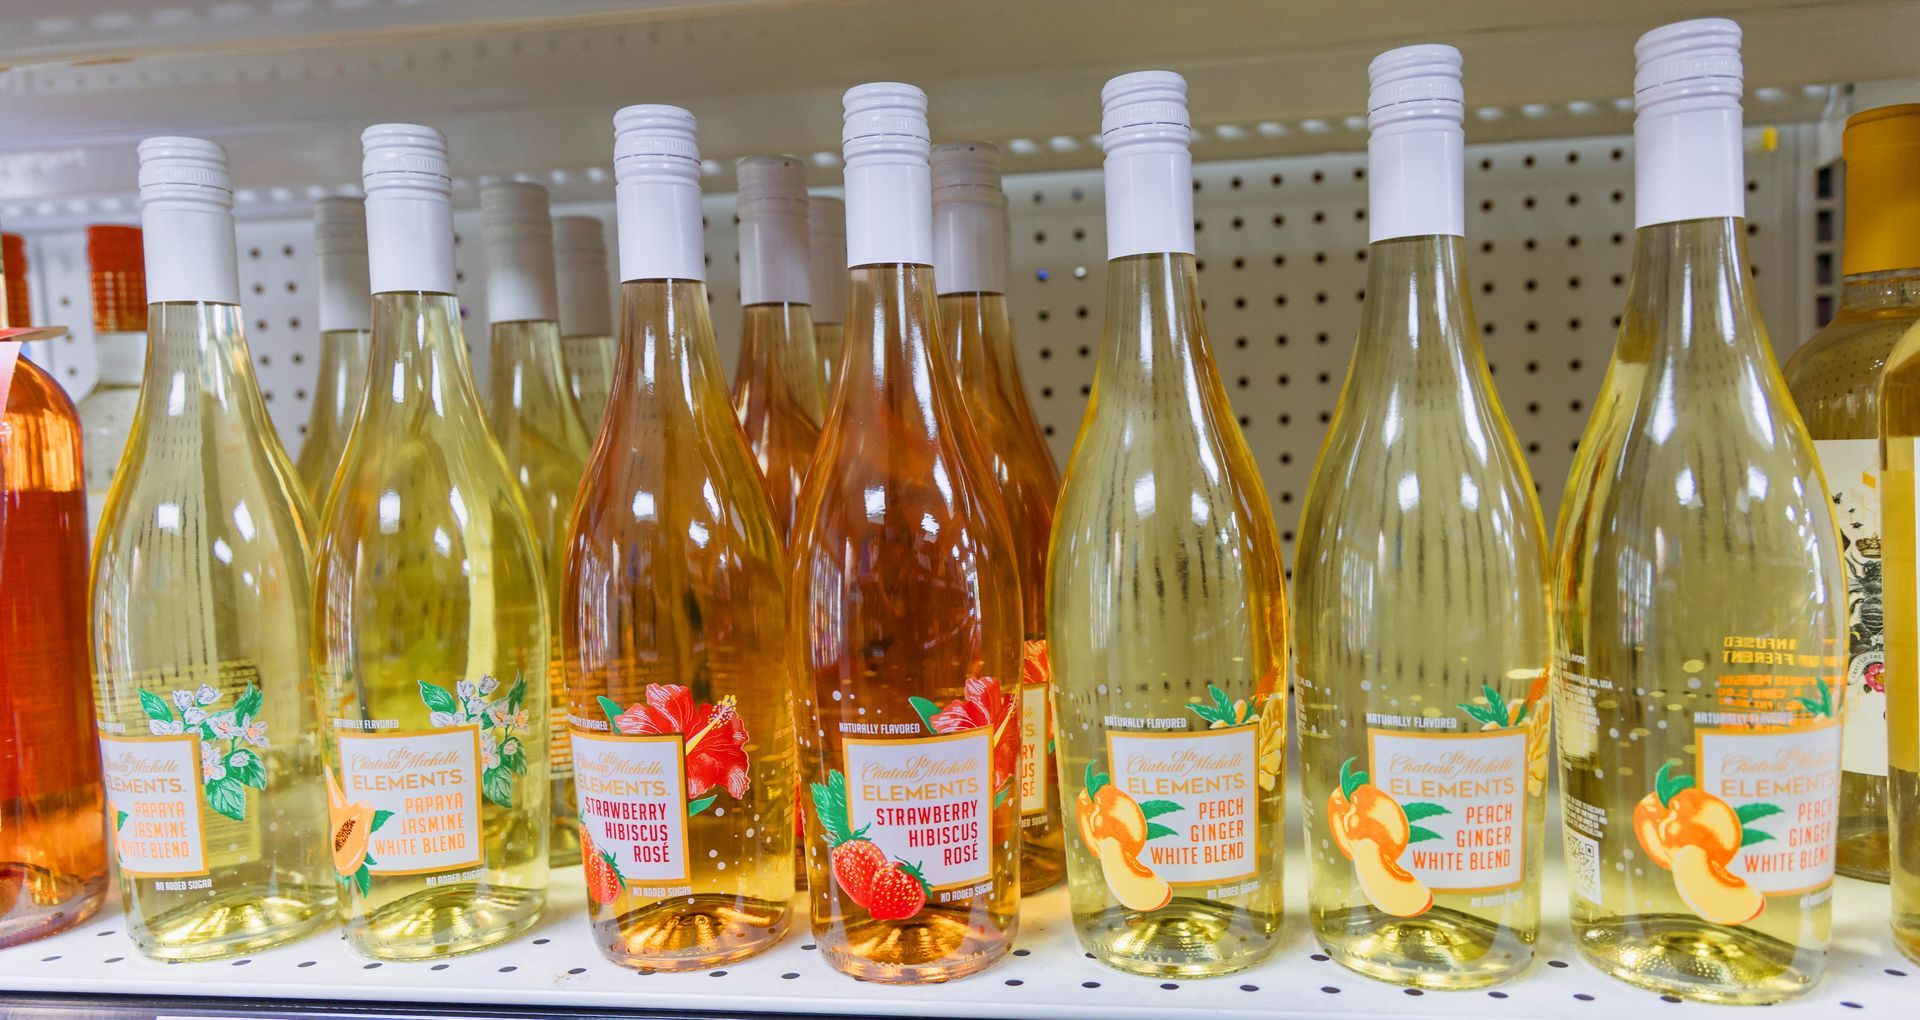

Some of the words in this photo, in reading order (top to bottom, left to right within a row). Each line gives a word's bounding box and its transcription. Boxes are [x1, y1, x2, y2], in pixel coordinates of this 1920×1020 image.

[1600, 680, 1613, 689] USA
[364, 718, 400, 729] FLAVORED
[839, 722, 878, 734] NATURALLY
[880, 722, 920, 734] FLAVORED
[1104, 716, 1144, 729] NATURALLY
[1146, 717, 1186, 729] FLAVORED
[1366, 712, 1412, 728] NATURALLY
[1414, 716, 1457, 729] FLAVORED
[1694, 712, 1747, 725] NATURALLY
[394, 751, 463, 774] Michelle
[603, 759, 664, 777] Michelle
[912, 756, 976, 783] Michelle
[1183, 752, 1242, 777] Michelle
[1448, 756, 1514, 779] Michelle
[135, 801, 185, 818] PAPAYA
[405, 792, 464, 814] PAPAYA
[586, 796, 666, 821] STRAWBERRY
[876, 800, 978, 826] STRAWBERRY
[1199, 798, 1244, 821] PEACH
[1466, 803, 1513, 825] PEACH
[1798, 798, 1832, 820] PEACH
[133, 821, 188, 838] JASMINE
[401, 813, 464, 836] JASMINE
[604, 822, 668, 842] HIBISCUS
[908, 822, 978, 848] HIBISCUS
[1190, 820, 1244, 842] GINGER
[1788, 822, 1831, 848] GINGER
[374, 839, 416, 856] WHITE
[422, 833, 466, 854] BLEND
[1456, 826, 1512, 848] GINGER
[152, 842, 190, 859] BLEND
[634, 842, 670, 863] ROSÉ
[944, 841, 978, 866] ROSÉ
[1150, 846, 1198, 865] WHITE
[1204, 842, 1244, 864] BLEND
[1412, 850, 1463, 871] WHITE
[1470, 848, 1510, 870] BLEND
[1744, 853, 1794, 873] WHITE
[1800, 845, 1830, 870] BLEND
[188, 878, 212, 890] SUGAR
[426, 876, 438, 887] NO
[438, 873, 461, 886] ADDED
[633, 886, 642, 896] NO
[644, 888, 666, 897] ADDED
[668, 886, 692, 897] SUGAR
[941, 892, 951, 903] NO
[952, 887, 973, 901] ADDED
[974, 882, 994, 896] SUGAR
[1218, 886, 1238, 898] ADDED
